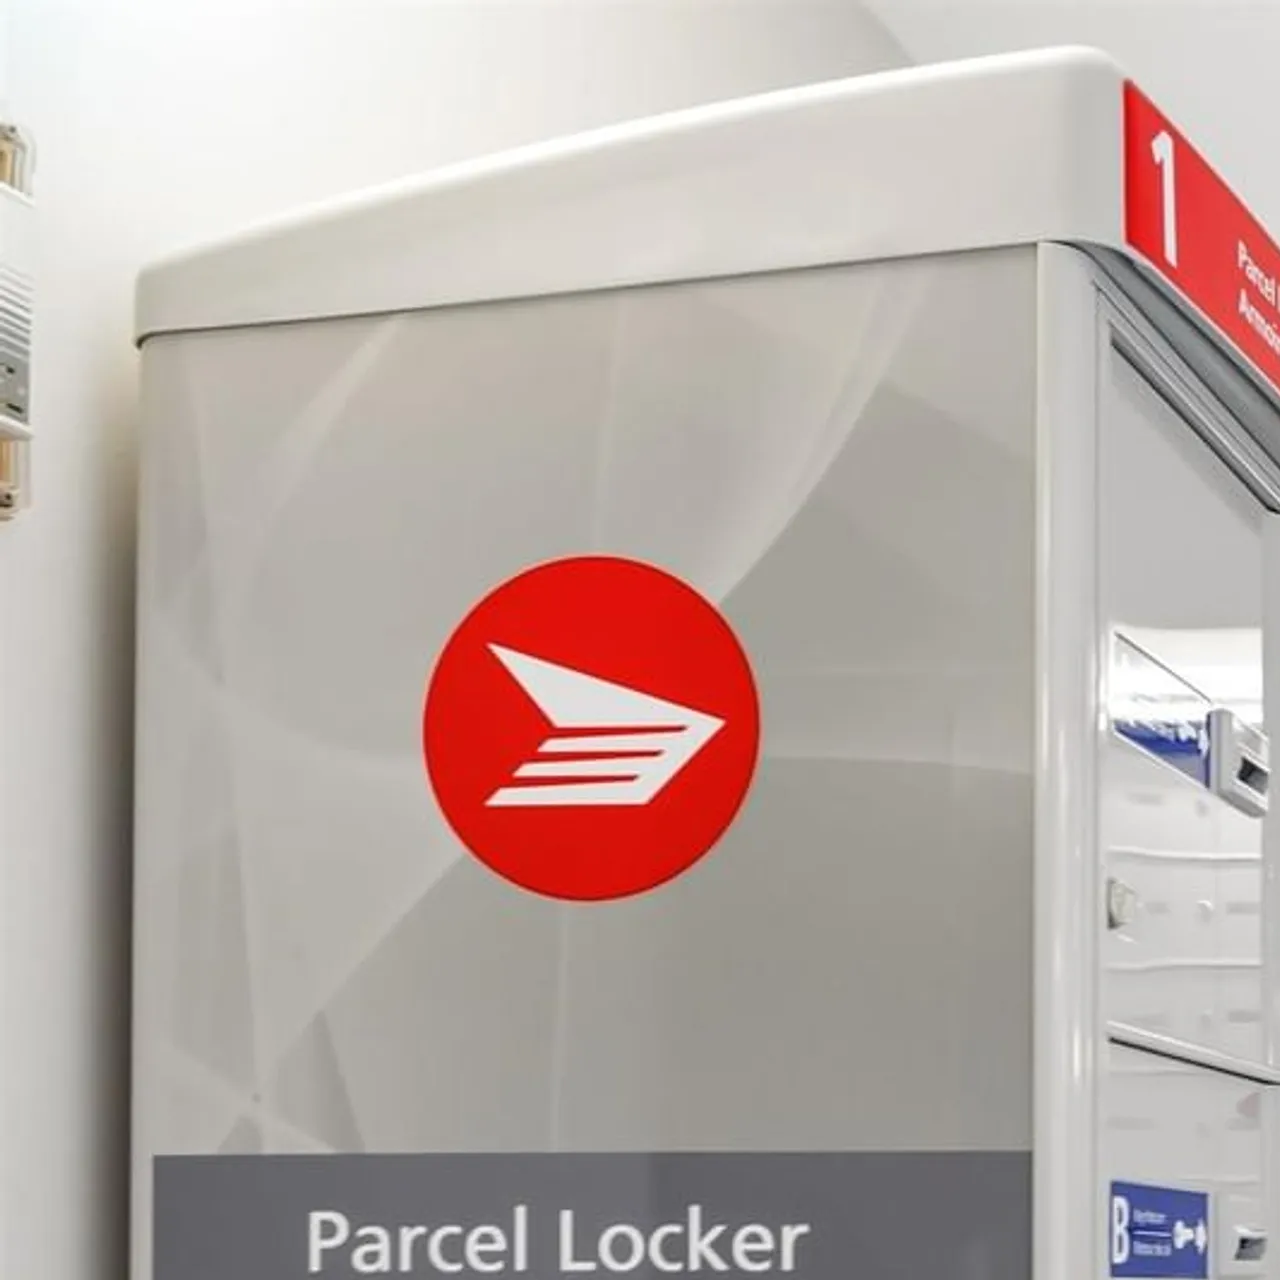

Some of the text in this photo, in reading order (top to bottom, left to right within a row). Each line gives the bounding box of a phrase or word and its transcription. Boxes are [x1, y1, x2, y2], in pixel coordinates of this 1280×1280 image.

[1151, 131, 1177, 267] 1
[1238, 240, 1276, 306] Parcel
[308, 1204, 810, 1273] Parcel Locker
[1113, 1195, 1130, 1265] B
